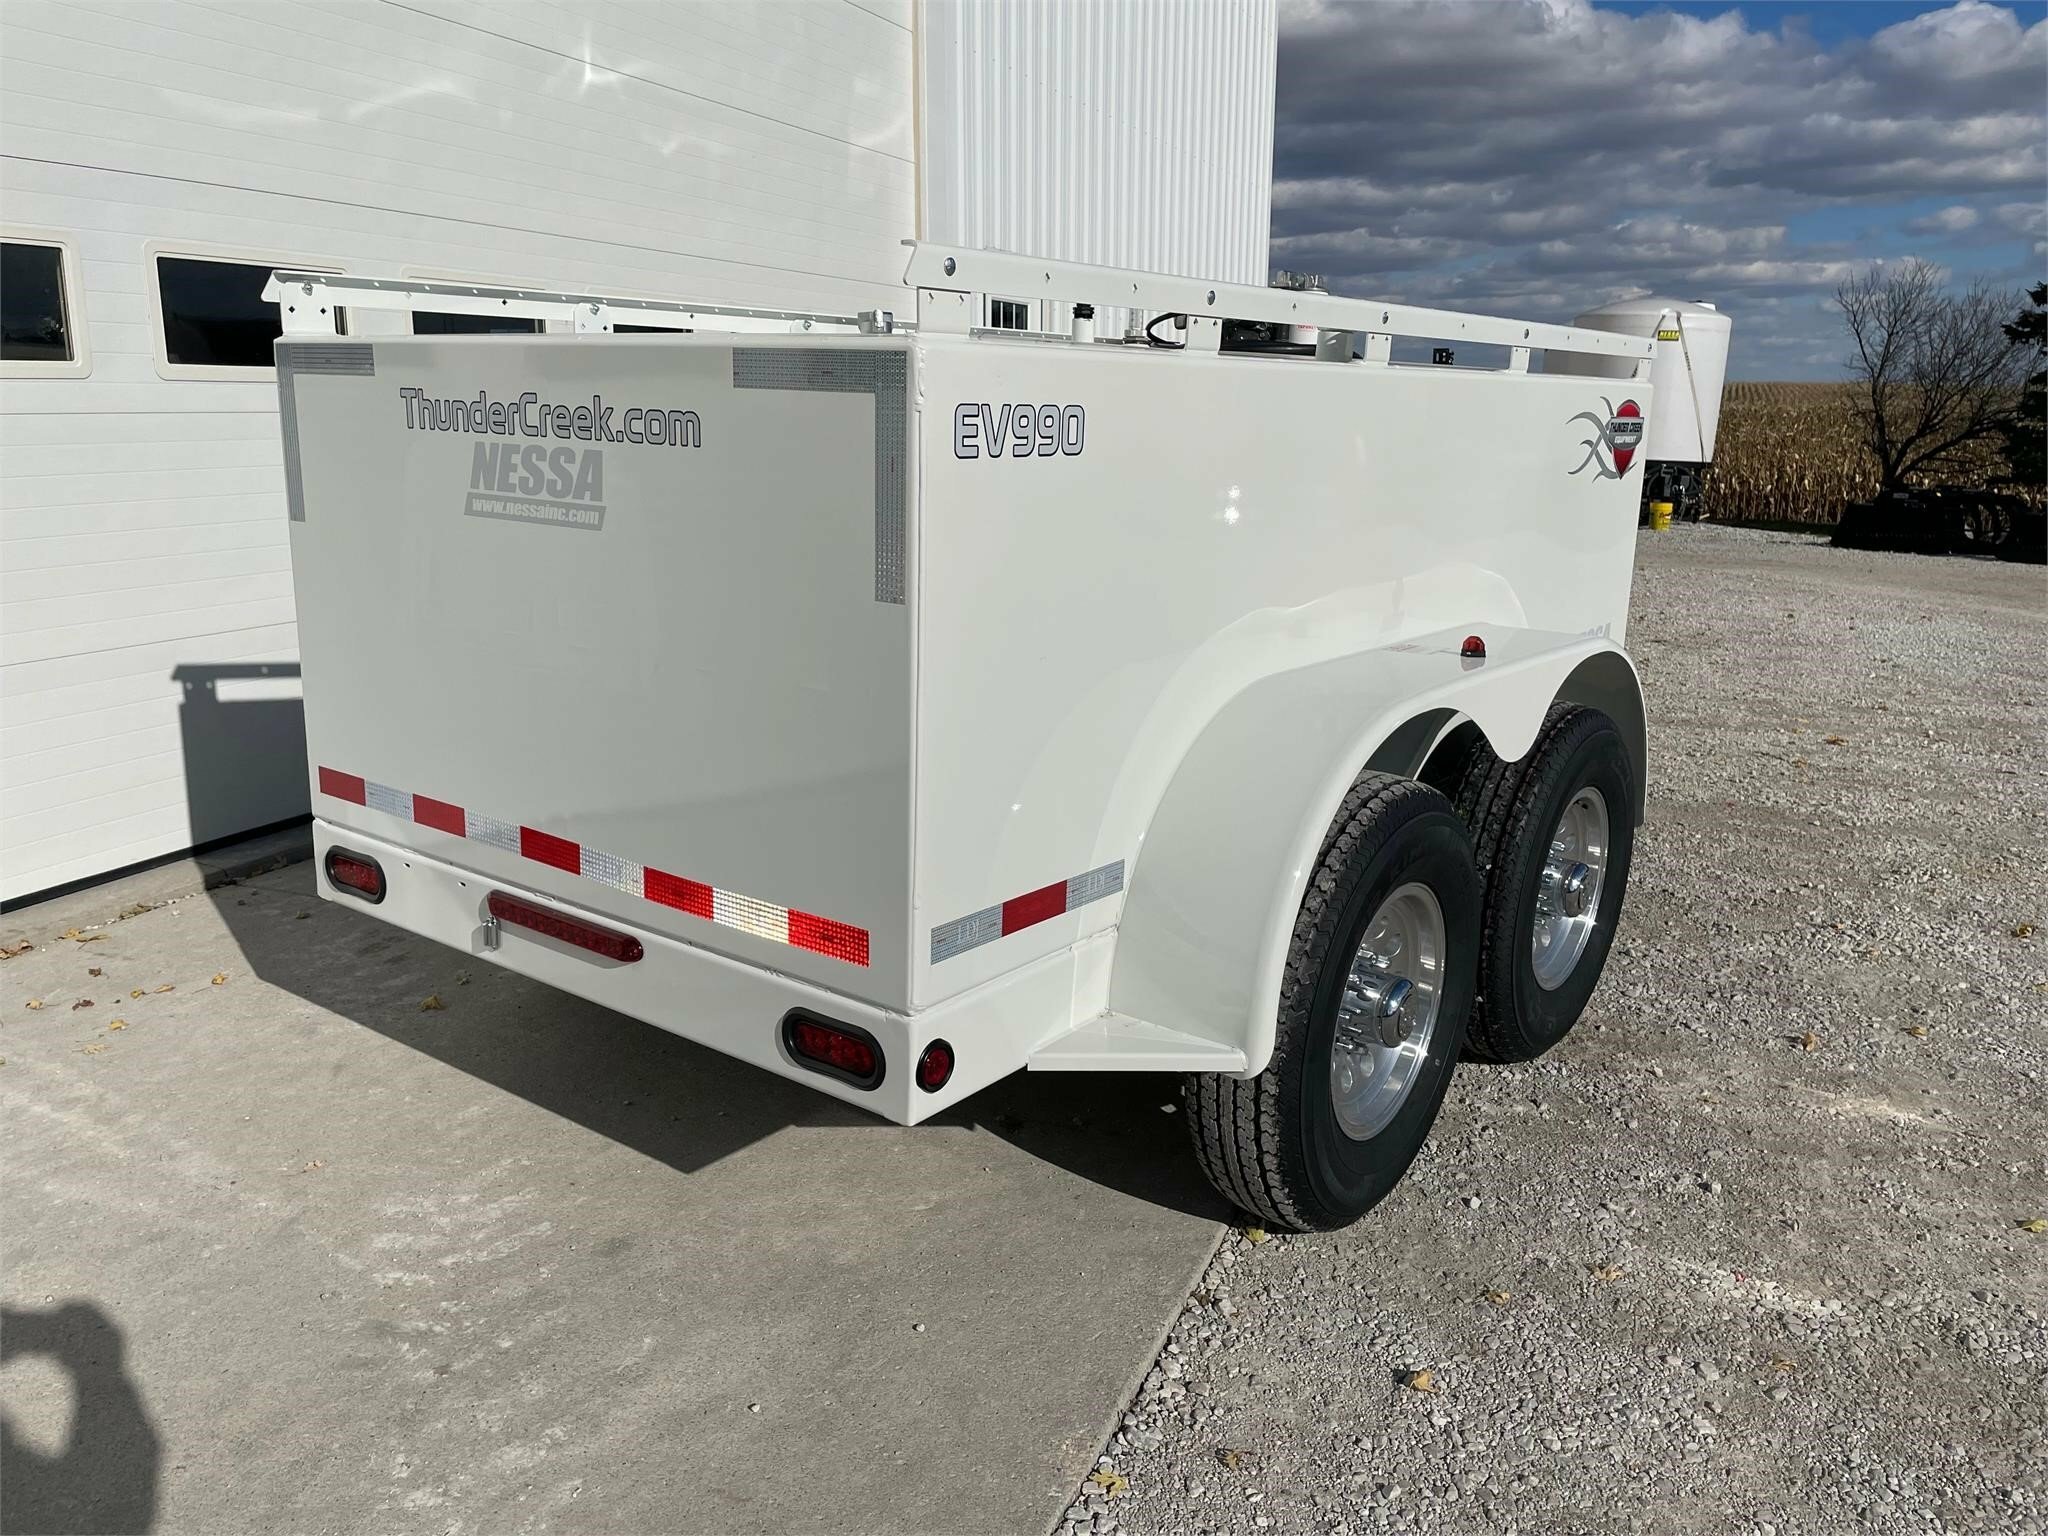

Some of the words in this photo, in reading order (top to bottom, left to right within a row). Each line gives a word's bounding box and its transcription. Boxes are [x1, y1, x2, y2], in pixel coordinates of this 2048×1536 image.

[400, 387, 702, 448] ThunderCreek.com
[954, 403, 1085, 459] EV990
[470, 441, 603, 502] NESSA
[472, 498, 600, 525] www.nessainc.com
